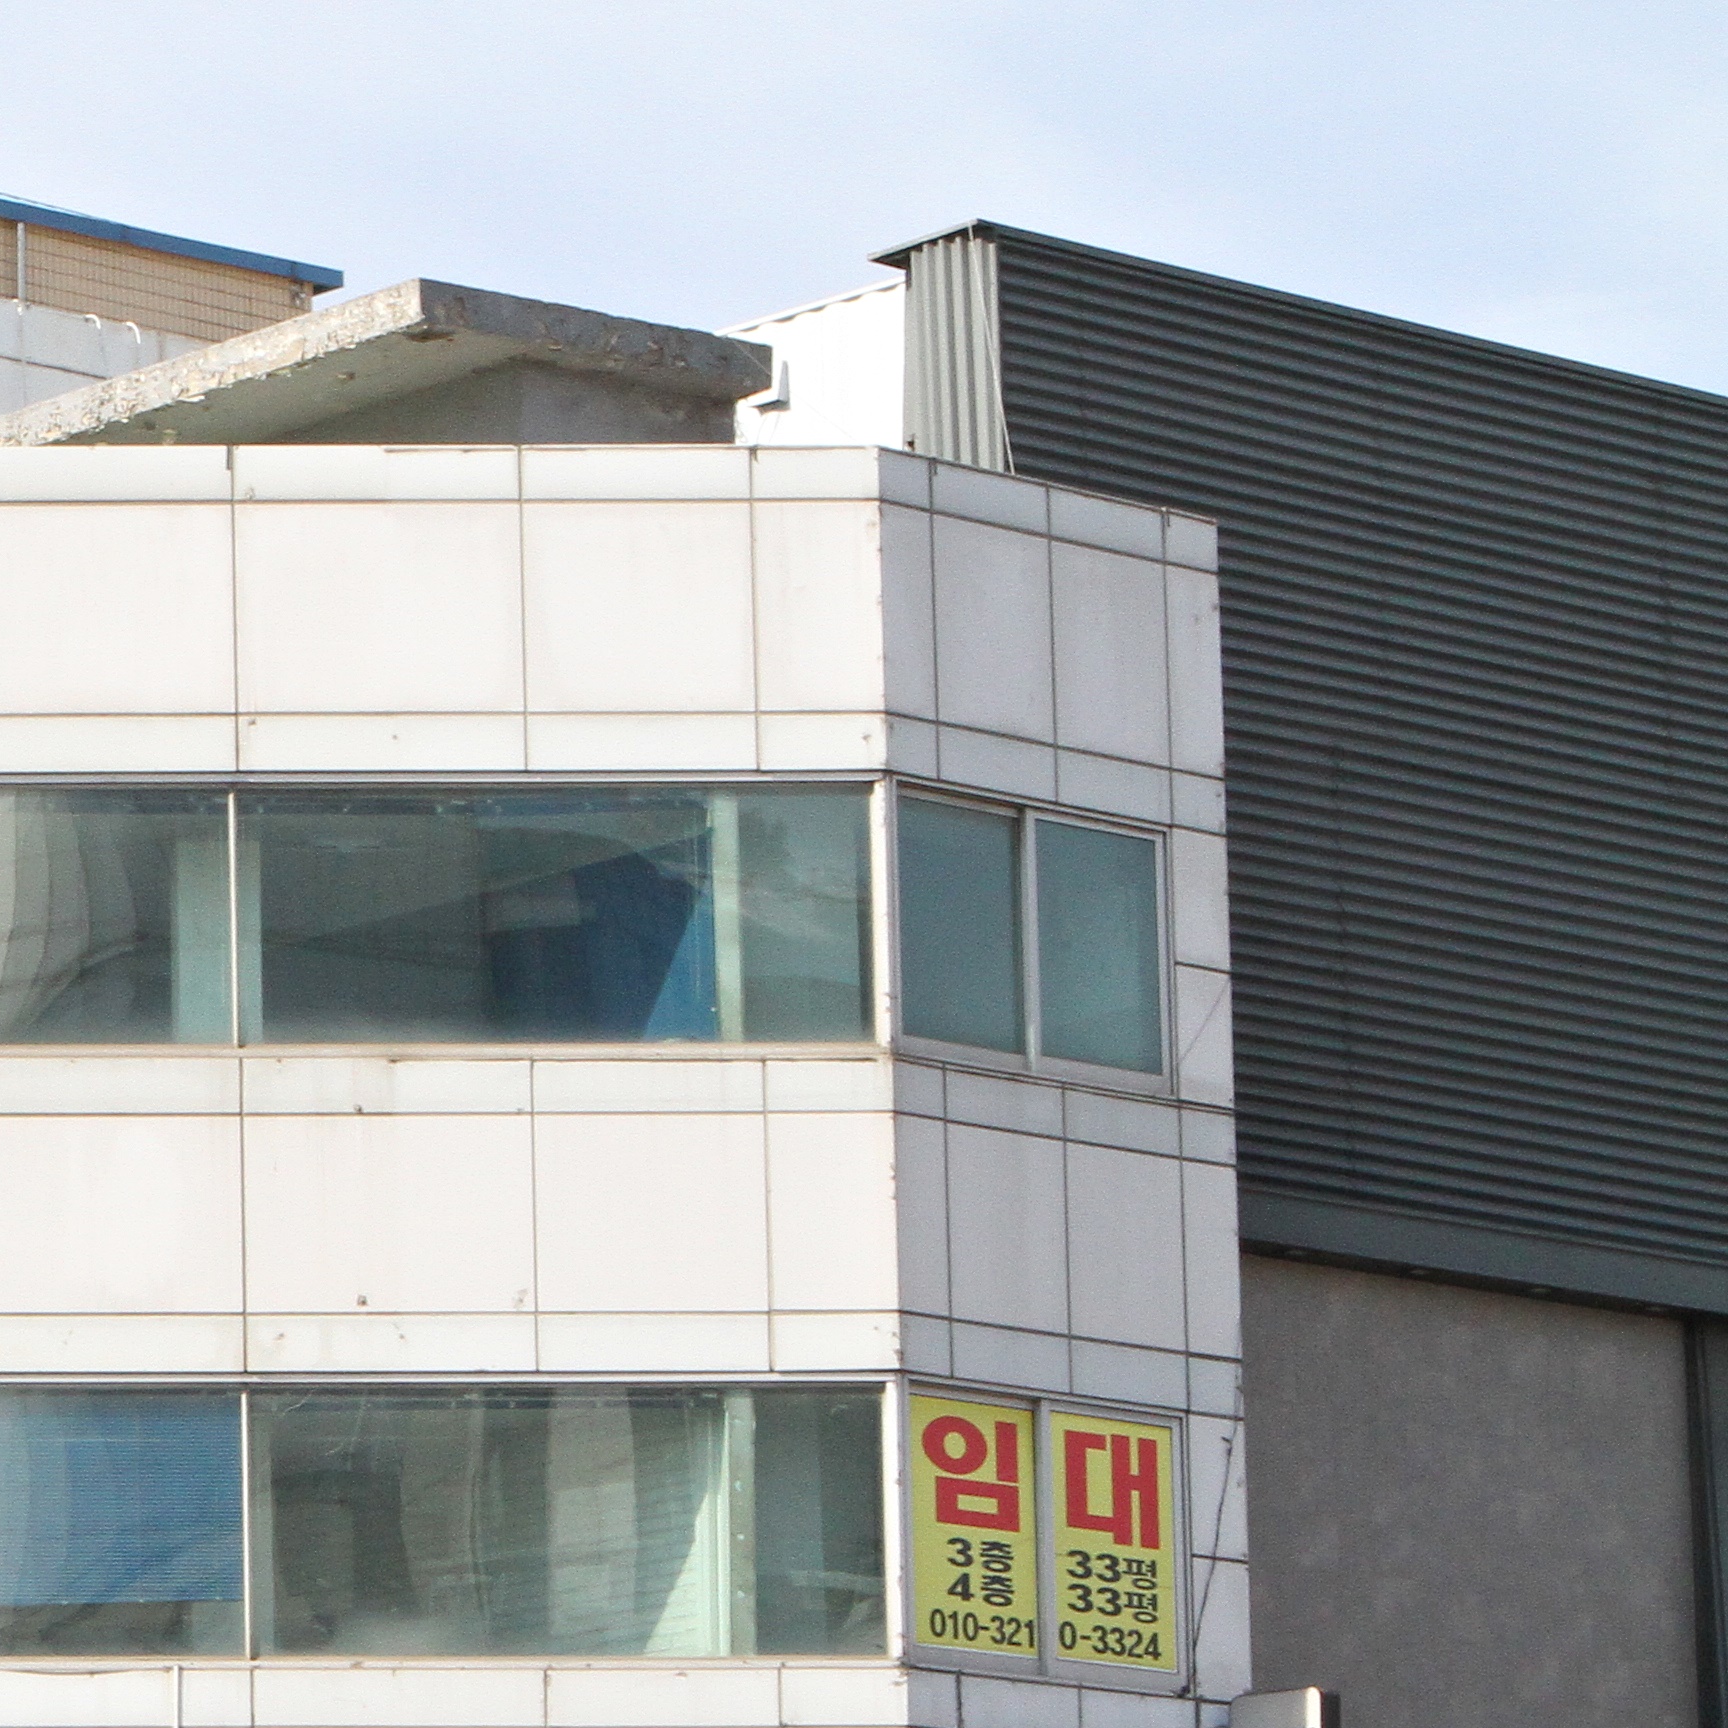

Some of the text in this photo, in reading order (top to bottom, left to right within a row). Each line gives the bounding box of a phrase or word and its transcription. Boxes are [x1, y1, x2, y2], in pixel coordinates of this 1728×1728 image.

[921, 1414, 1160, 1550] 임대
[946, 1537, 1157, 1591] 3층 33평
[947, 1572, 1159, 1624] 4층 33평
